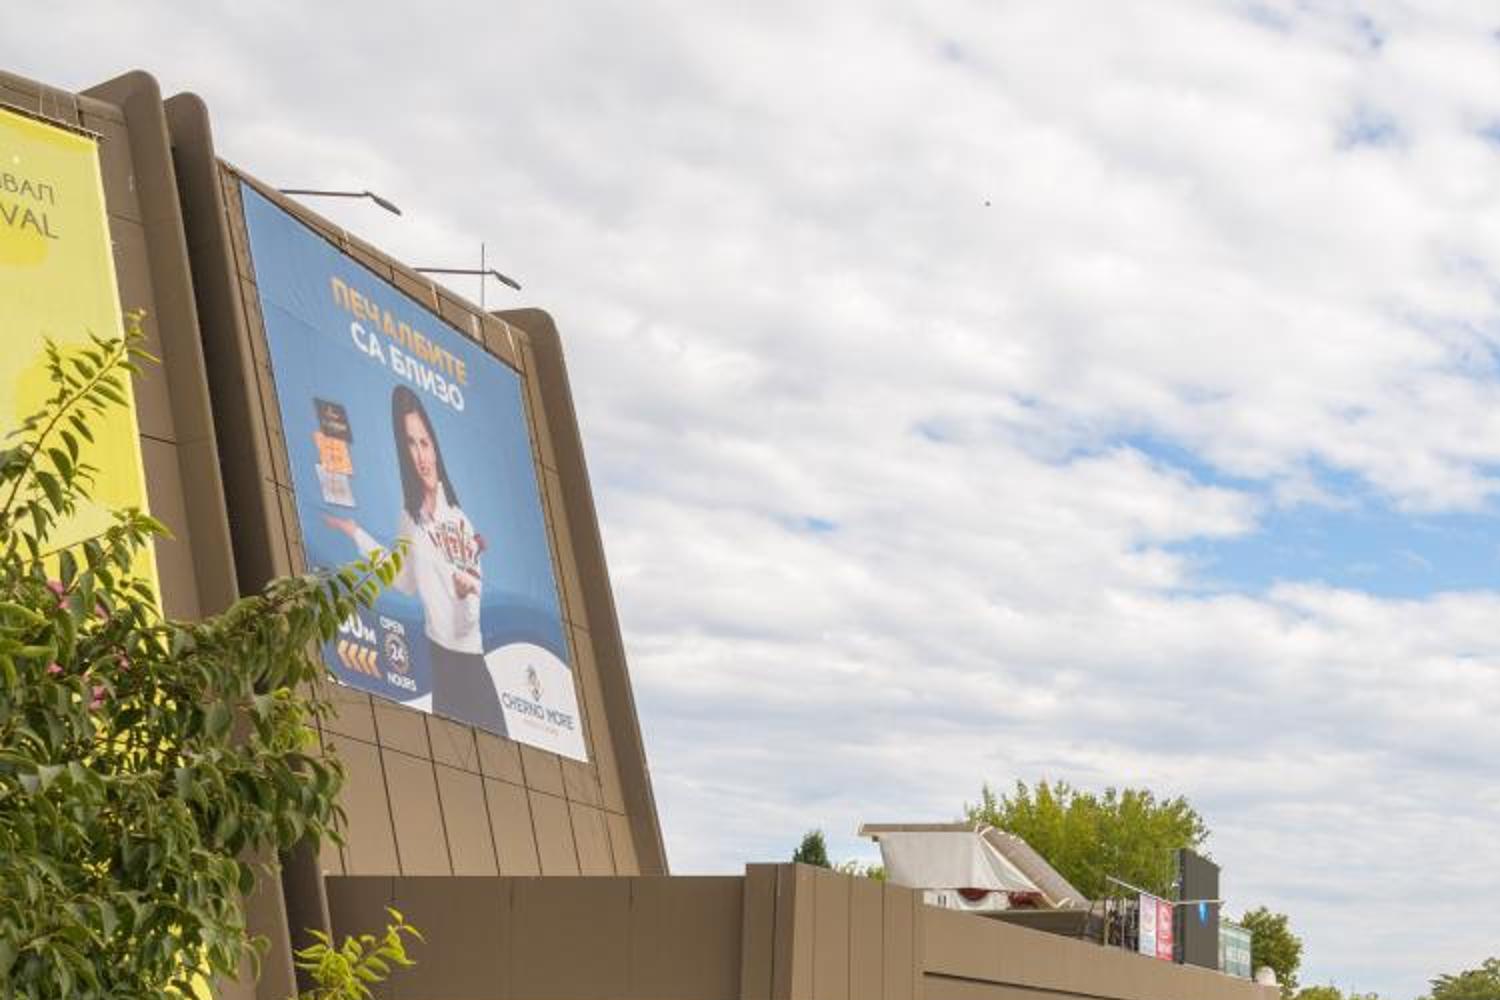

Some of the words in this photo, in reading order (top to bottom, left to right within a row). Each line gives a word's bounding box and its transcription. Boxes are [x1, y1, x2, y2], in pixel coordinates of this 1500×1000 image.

[0, 172, 55, 206] ВАЛ
[0, 203, 60, 240] VAL
[331, 276, 467, 385] ПЕЧАЛБИТЕ
[351, 321, 386, 365] СА
[389, 343, 465, 412] БЛИЗО
